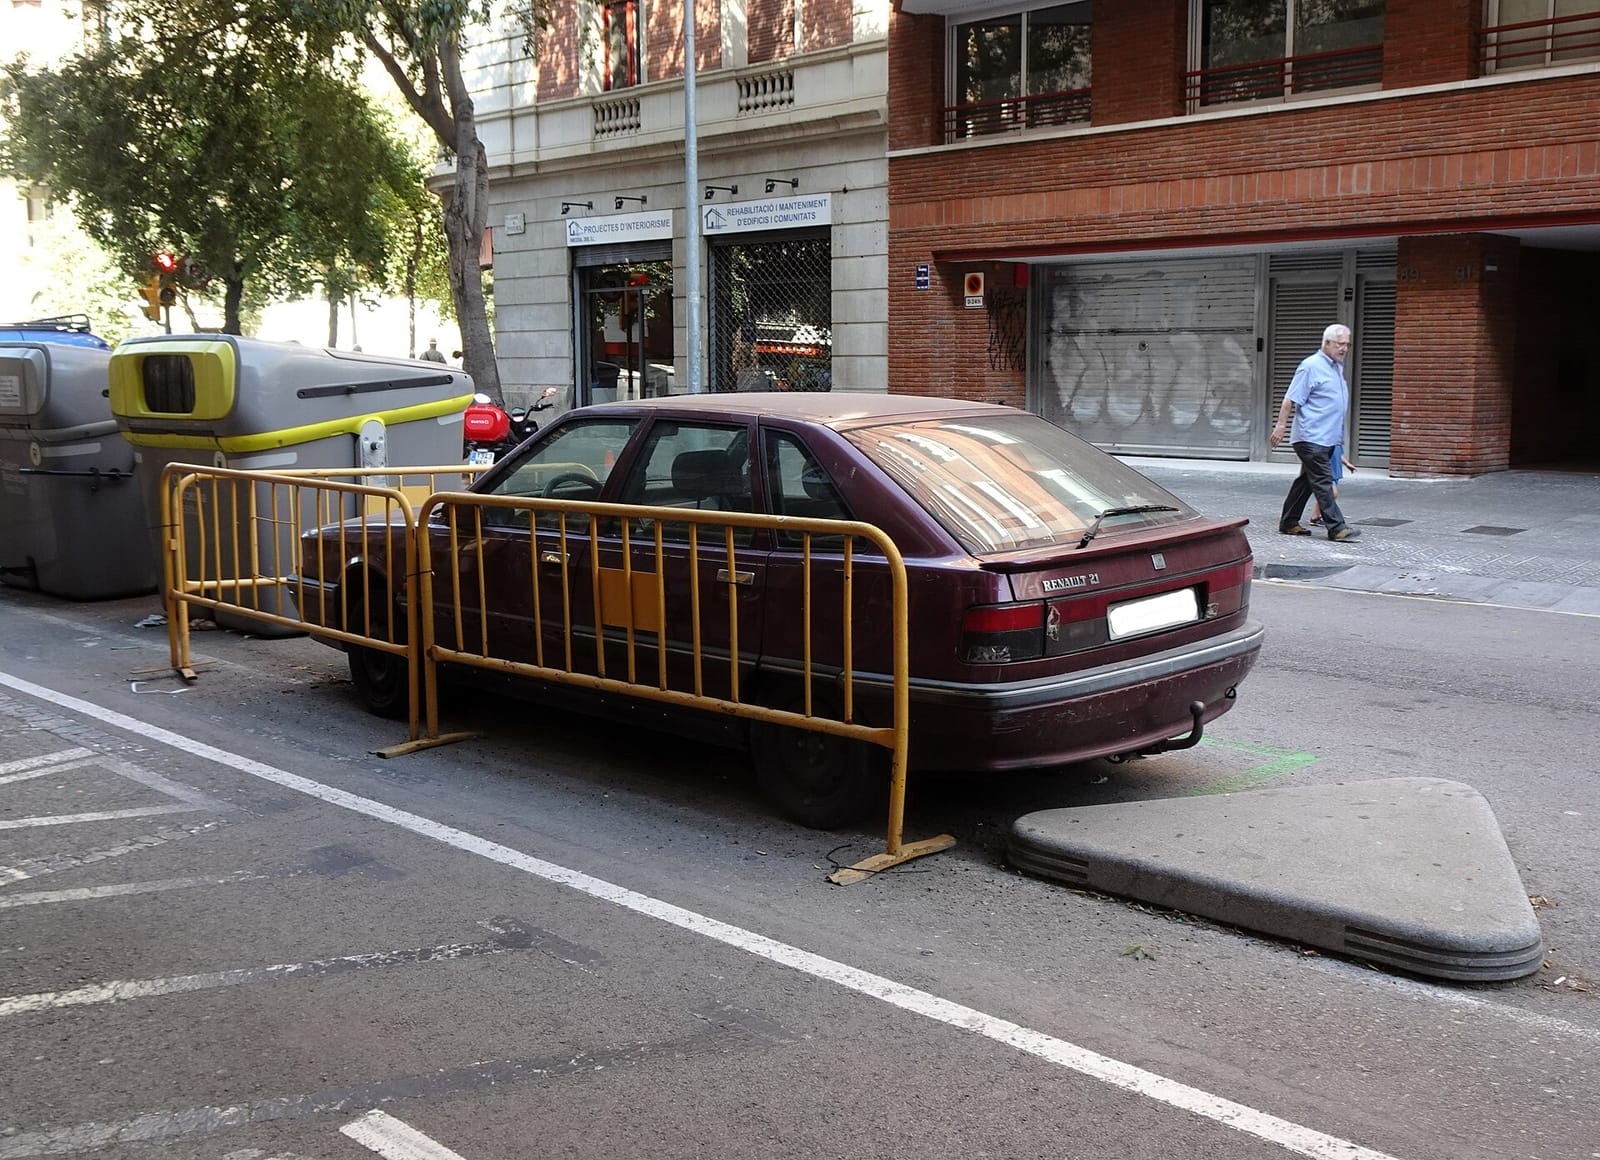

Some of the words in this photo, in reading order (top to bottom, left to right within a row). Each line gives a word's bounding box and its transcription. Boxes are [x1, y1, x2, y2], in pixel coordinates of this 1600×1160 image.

[727, 202, 773, 216] REHABILITACIÓ
[779, 199, 827, 211] MANTENIMENT
[584, 223, 620, 233] PROJECTES
[620, 219, 670, 231] D'INTERIORISME
[737, 216, 769, 226] D'EDIFICIS
[774, 212, 816, 222] COMUNITATS
[1043, 575, 1087, 592] RENAULT
[1089, 573, 1099, 584] 21
